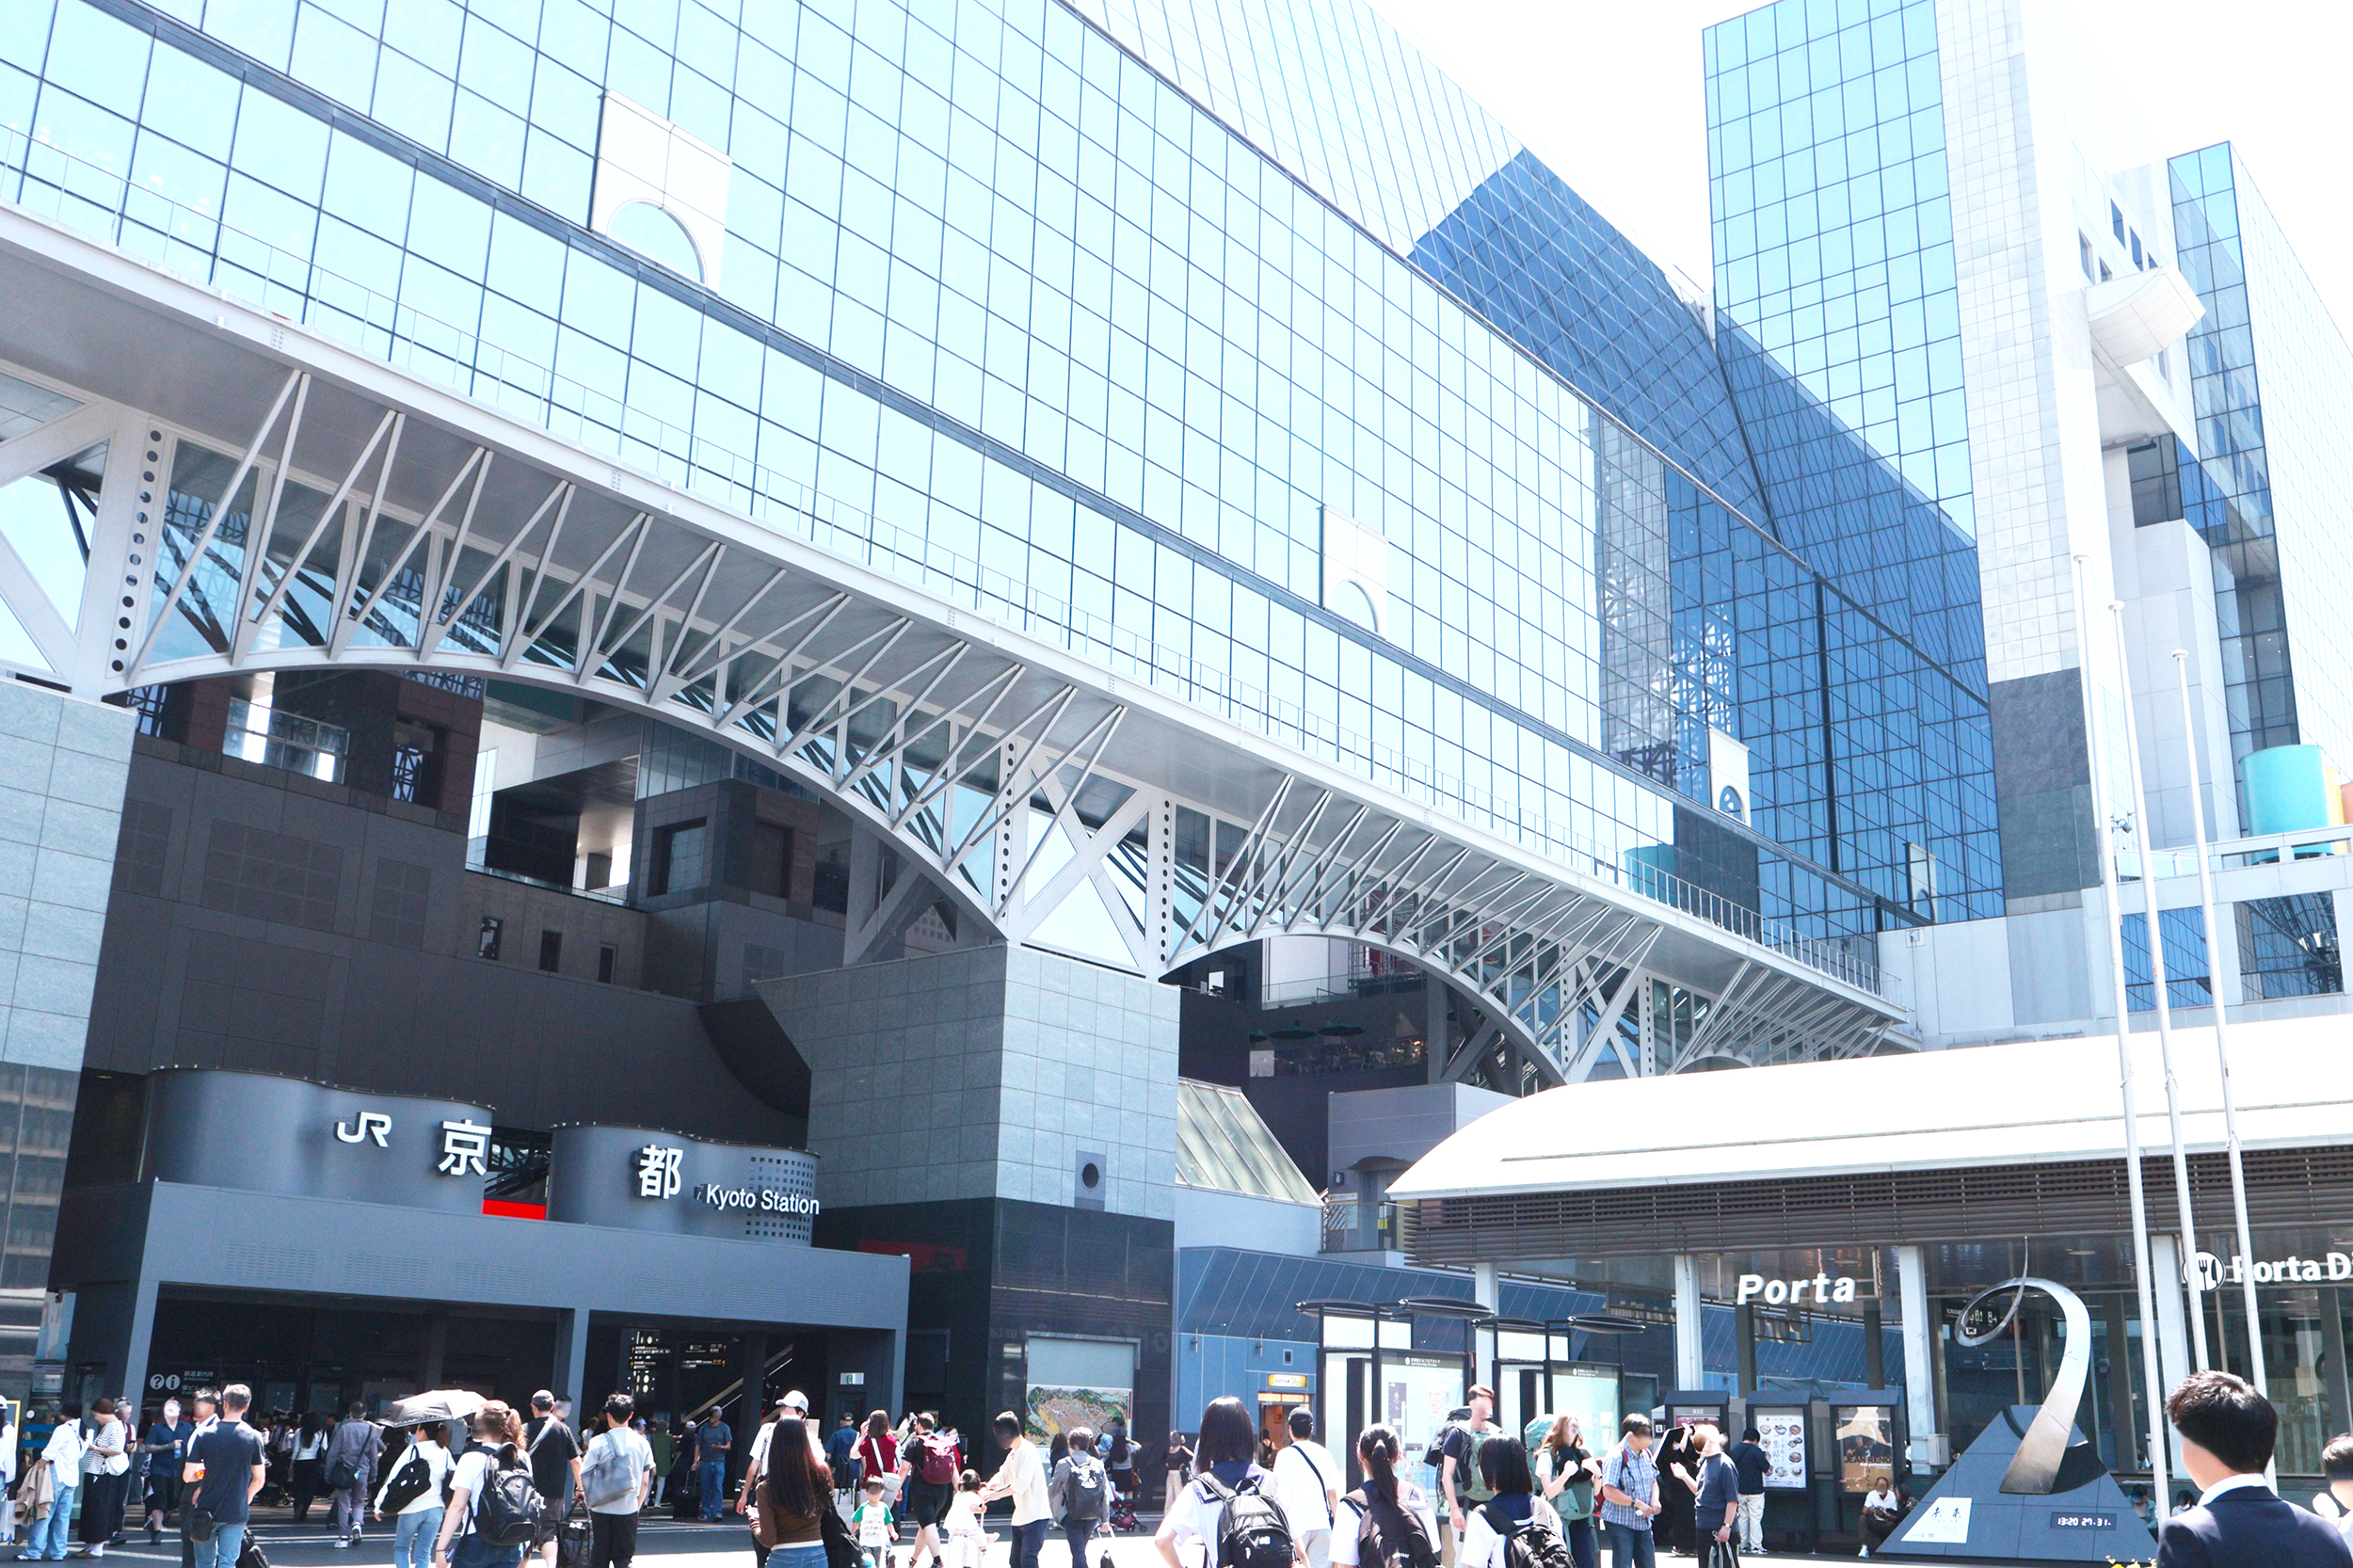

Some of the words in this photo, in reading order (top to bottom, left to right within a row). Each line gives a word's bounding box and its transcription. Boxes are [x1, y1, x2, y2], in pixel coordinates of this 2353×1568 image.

[336, 1111, 392, 1147] JR
[438, 1118, 492, 1176] 京
[637, 1144, 684, 1200] 都
[706, 1183, 757, 1210] Kyoto
[760, 1189, 820, 1215] Station
[2232, 1255, 2322, 1284] Porta
[2326, 1250, 2353, 1281] D
[1737, 1272, 1856, 1305] Porta
[1844, 1455, 1865, 1464] JEAN
[1868, 1455, 1892, 1464] RENO
[2057, 1516, 2079, 1527] 13:20
